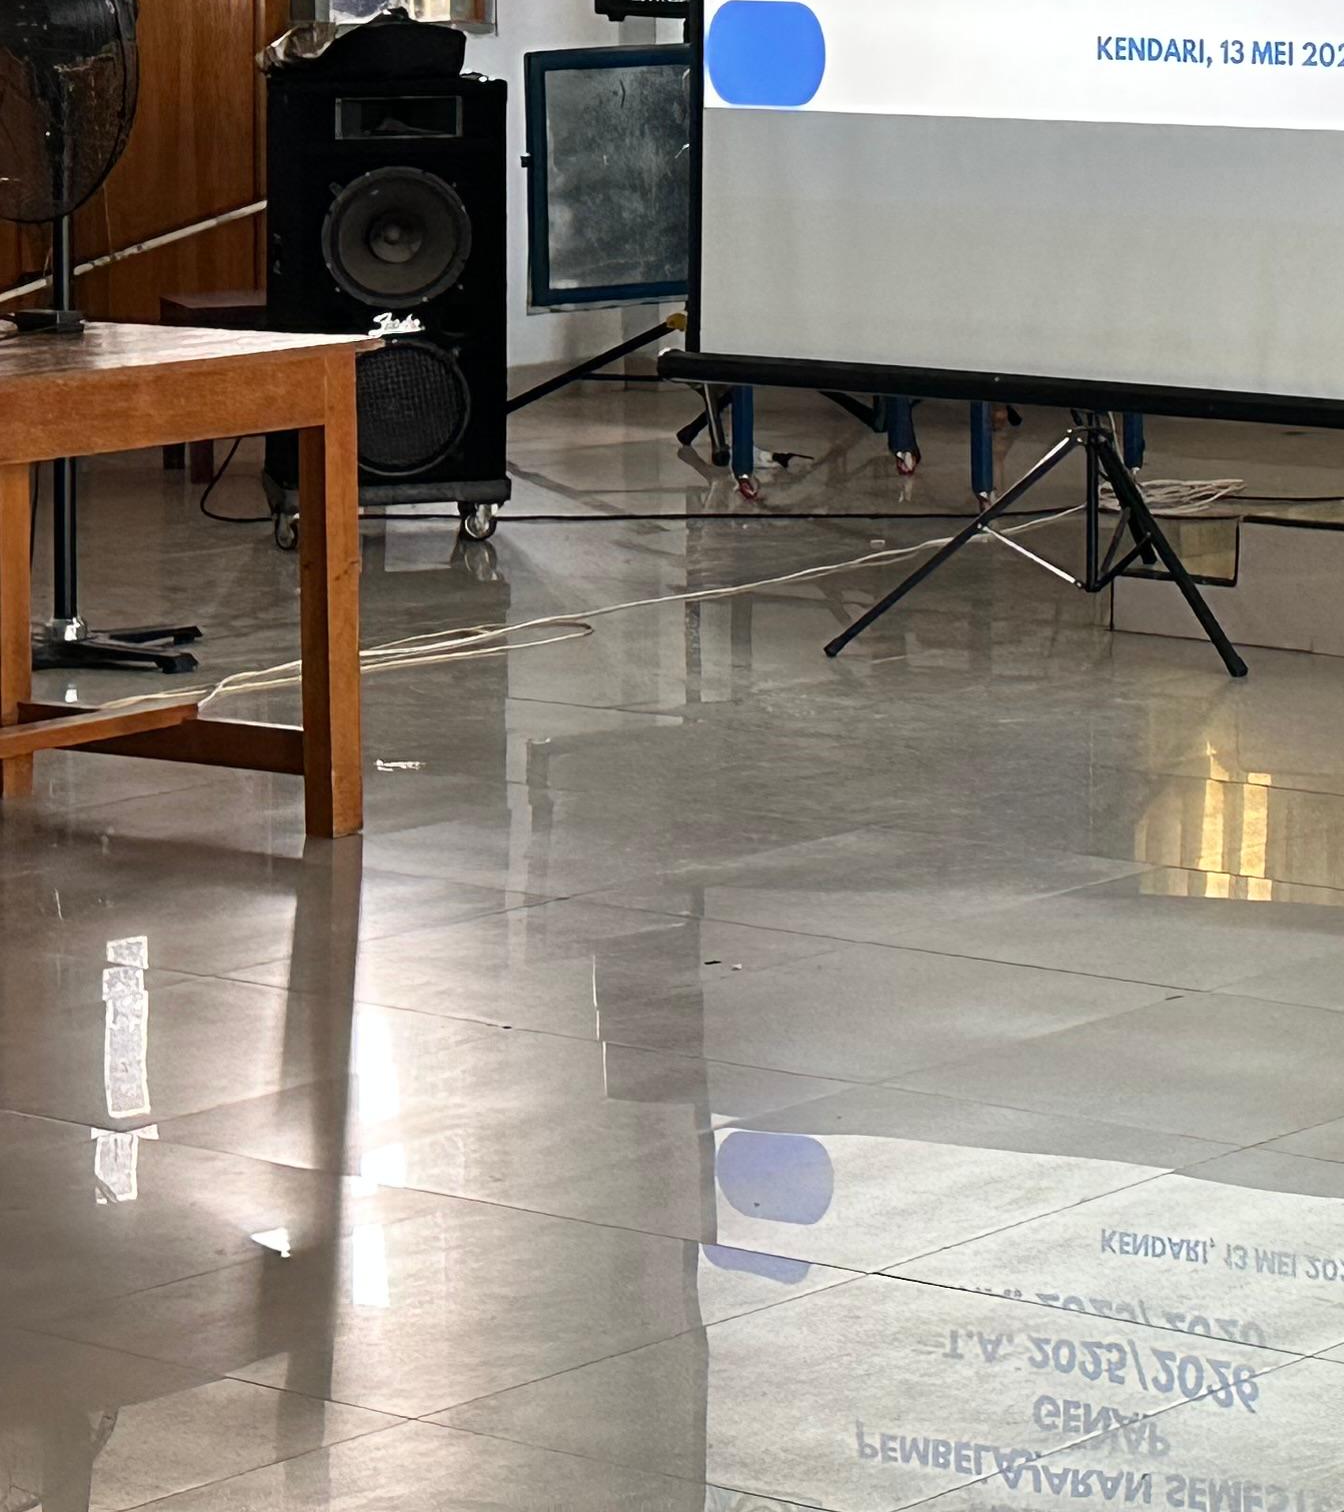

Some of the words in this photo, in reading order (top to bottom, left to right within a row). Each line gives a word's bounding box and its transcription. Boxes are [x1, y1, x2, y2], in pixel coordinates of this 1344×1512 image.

[1096, 37, 1213, 67] KENDARI,
[1220, 40, 1245, 66] 13
[1251, 40, 1295, 67] MEI
